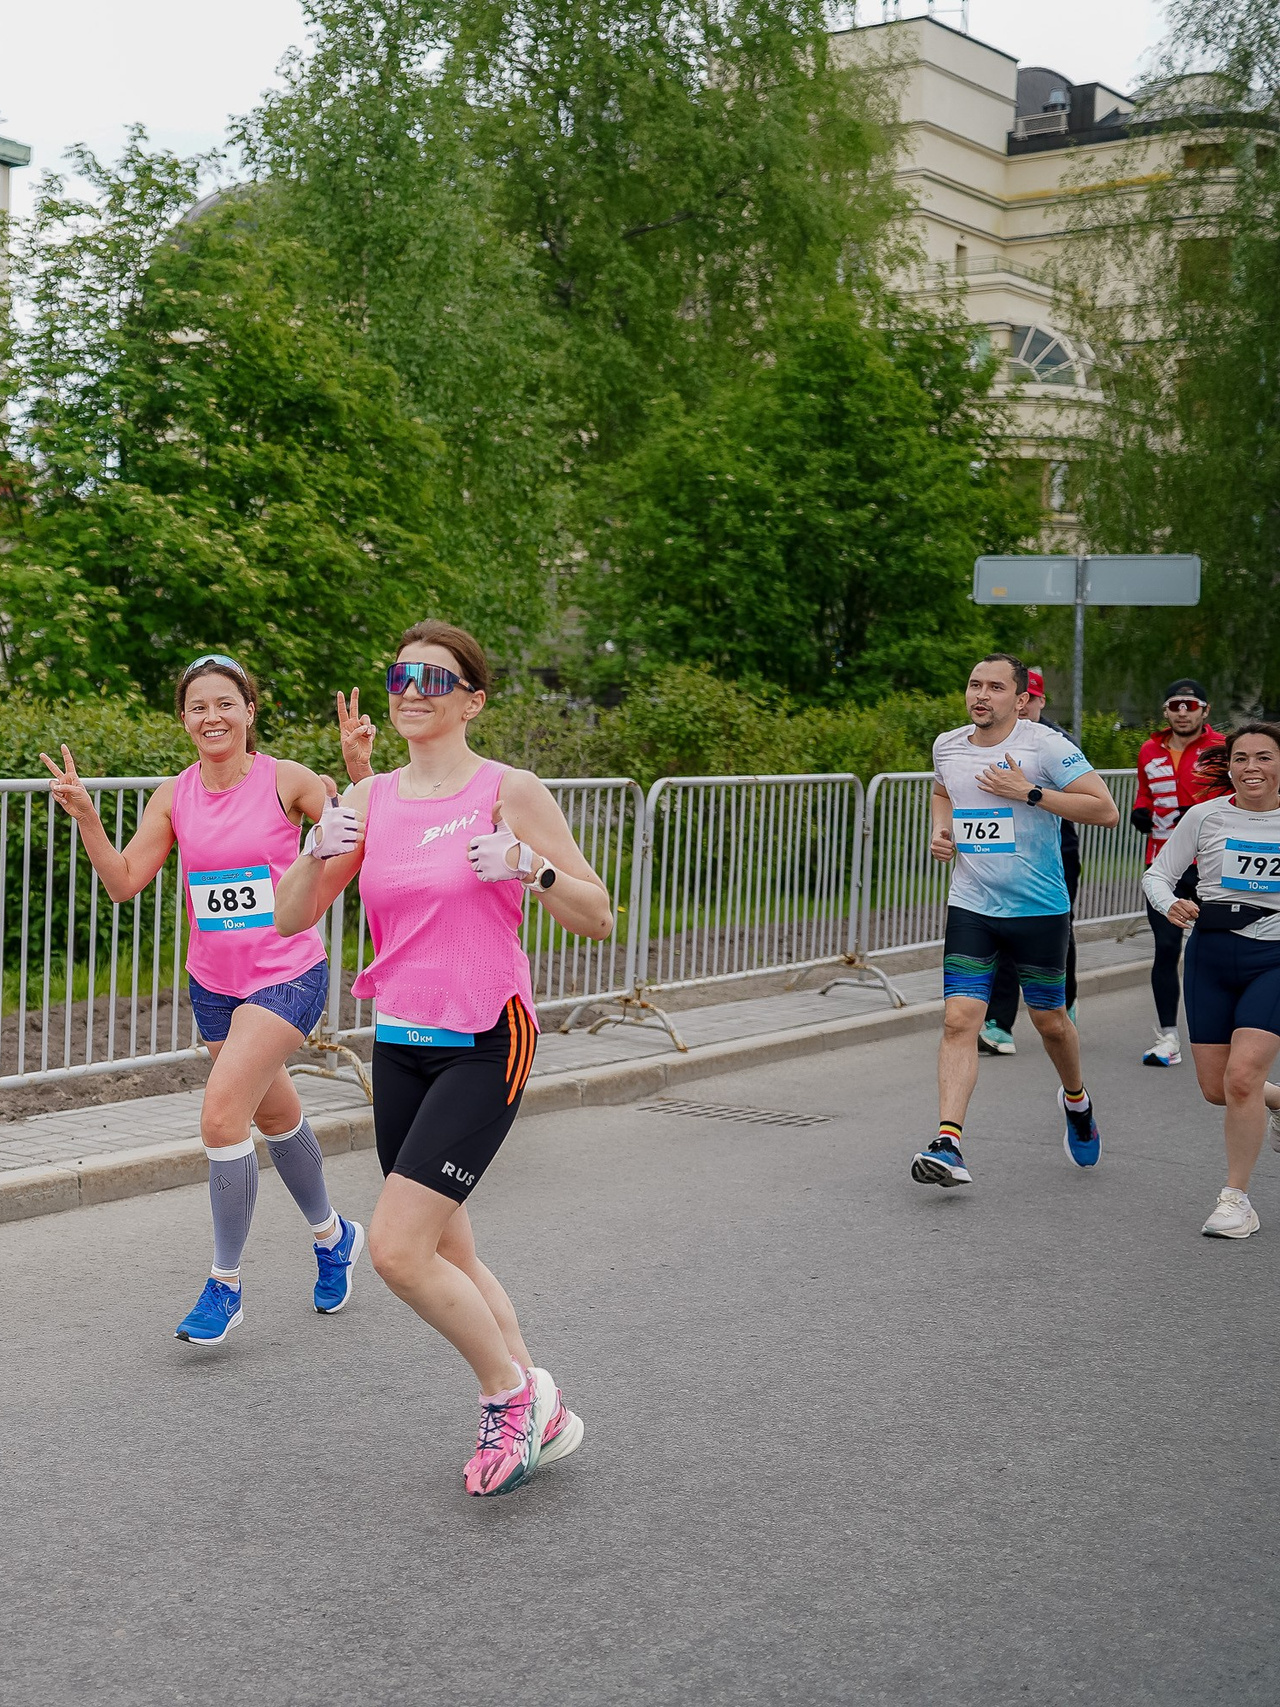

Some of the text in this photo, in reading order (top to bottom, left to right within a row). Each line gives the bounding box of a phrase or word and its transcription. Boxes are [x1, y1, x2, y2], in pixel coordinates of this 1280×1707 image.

[963, 821, 1001, 840] 762
[1237, 855, 1280, 877] 792
[207, 886, 257, 913] 683
[441, 1161, 475, 1186] RUS
